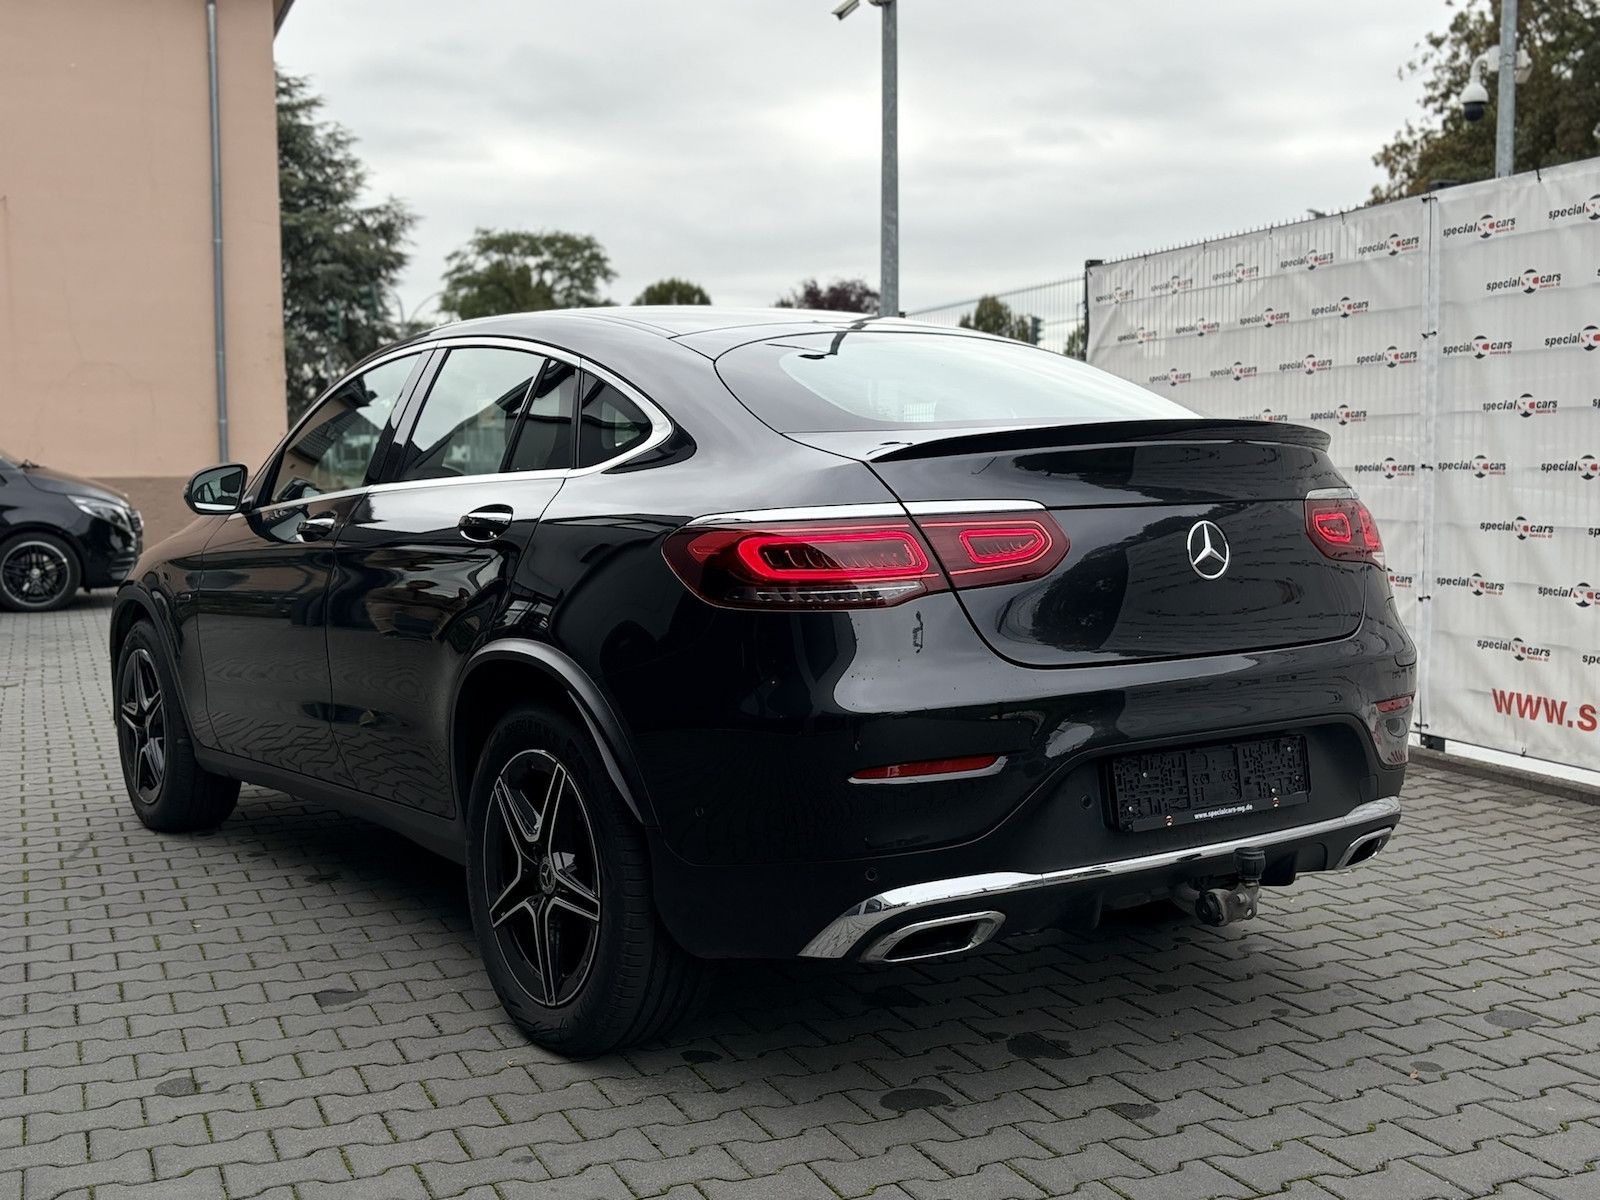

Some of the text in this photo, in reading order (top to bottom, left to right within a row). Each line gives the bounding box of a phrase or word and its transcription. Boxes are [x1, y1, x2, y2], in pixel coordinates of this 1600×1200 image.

[1548, 202, 1586, 220] special
[1443, 217, 1515, 237] special cars
[1486, 273, 1561, 291] special cars
[1311, 303, 1341, 315] special
[1544, 333, 1581, 347] special
[1443, 340, 1512, 354] special cars
[1356, 351, 1417, 364] special cars
[1483, 400, 1557, 413] special cars
[1354, 463, 1415, 474] special cars
[1438, 461, 1506, 472] special cars
[1540, 461, 1578, 473] special
[1480, 521, 1554, 534] special cars
[1436, 576, 1504, 591] special cars
[1537, 586, 1574, 597] special
[1476, 638, 1551, 657] special cars
